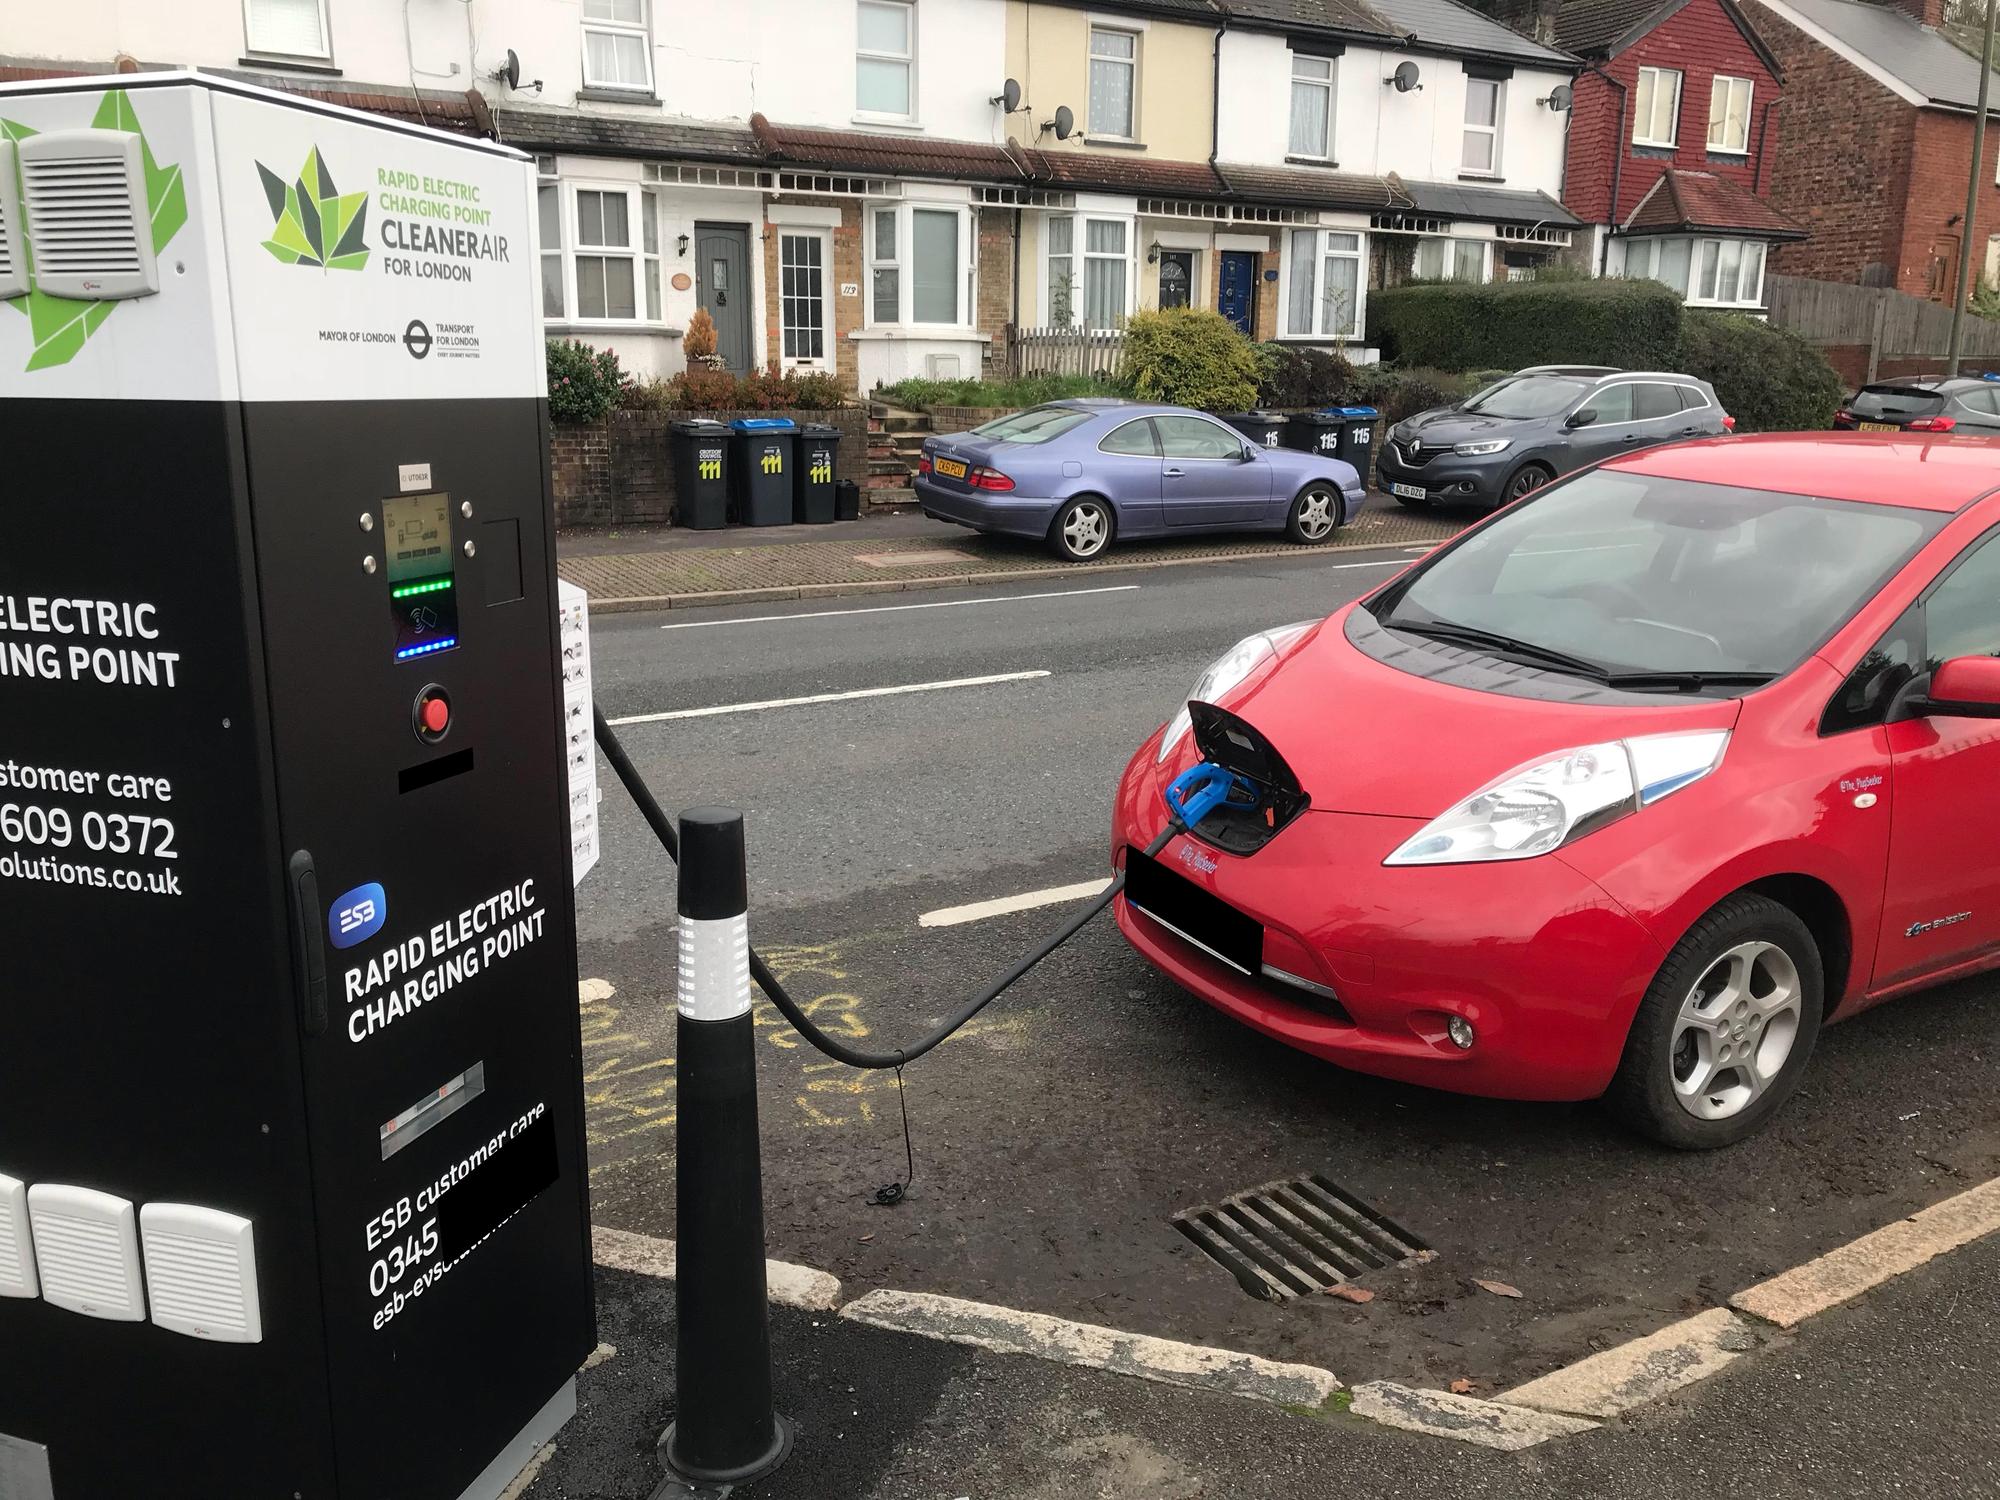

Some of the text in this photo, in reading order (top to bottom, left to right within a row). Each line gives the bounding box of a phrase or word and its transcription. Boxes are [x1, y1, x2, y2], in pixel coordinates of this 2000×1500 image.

[377, 167, 480, 202] RAPID ELECTRIC
[379, 192, 491, 226] CHARGING POINT
[381, 219, 510, 263] CLEANERAIR
[384, 257, 472, 282] FOR LONDON
[318, 330, 396, 343] MAYOR OF LONDON
[435, 323, 474, 334] TRANSPORT
[436, 336, 479, 346] FOR LONDON
[1265, 431, 1278, 446] 115
[1320, 433, 1337, 449] 115
[1352, 428, 1370, 444] 115
[699, 460, 721, 479] 111
[761, 455, 782, 473] 111
[810, 465, 831, 484] 111
[1396, 484, 1409, 495] DL16
[0, 641, 180, 688] ING POINT
[0, 760, 172, 801] stomer care
[0, 803, 178, 859] 609 0372
[0, 851, 182, 896] olutions.co.uk
[339, 899, 375, 934] ESB
[344, 878, 535, 1003] RAPID ELECTRIC
[348, 908, 545, 1043] CHARGING POINT
[366, 1197, 412, 1252] ESB
[416, 1130, 507, 1212] customer
[510, 1102, 545, 1140] care
[369, 1217, 439, 1297] 0345
